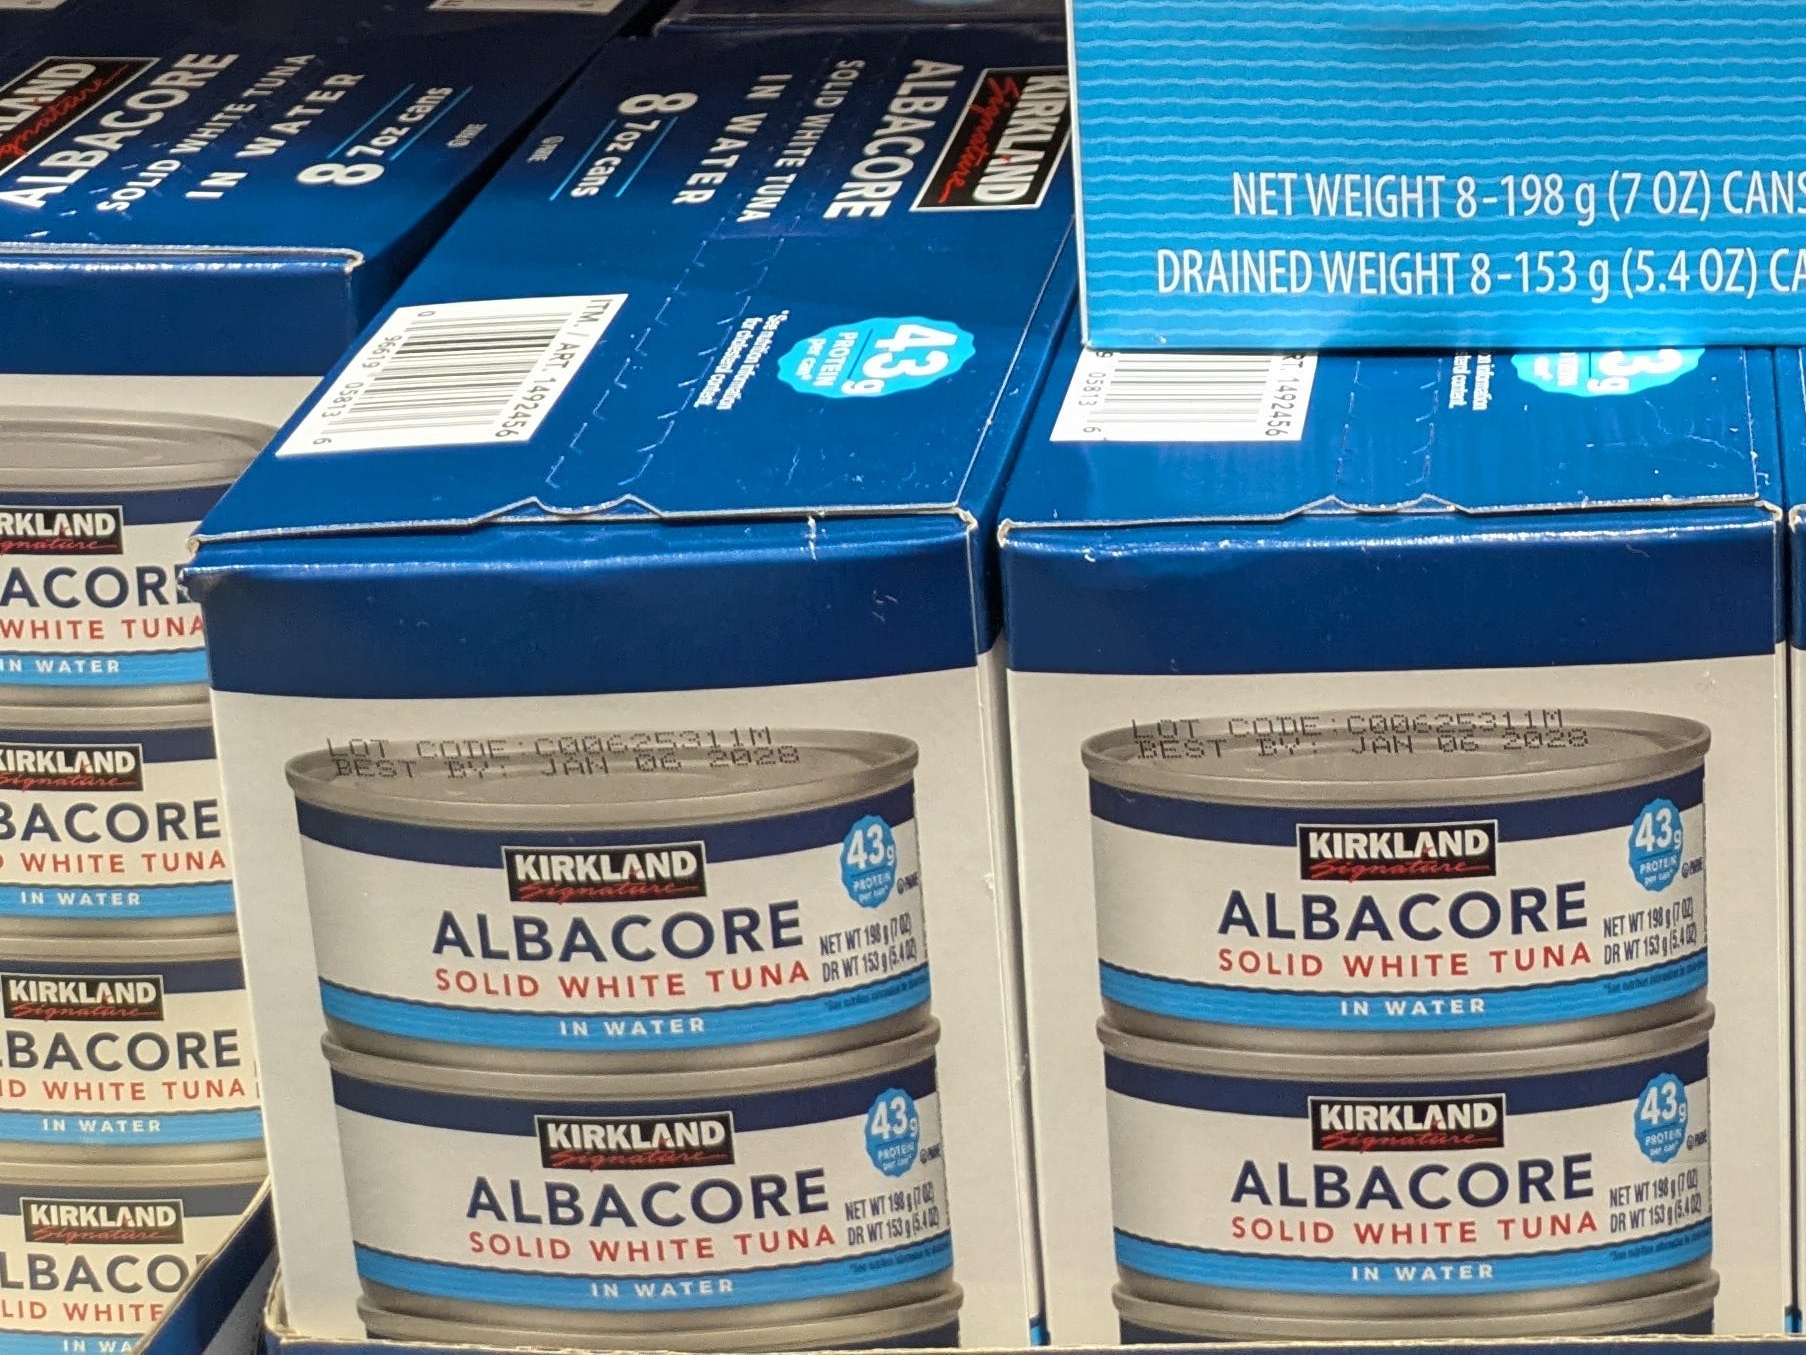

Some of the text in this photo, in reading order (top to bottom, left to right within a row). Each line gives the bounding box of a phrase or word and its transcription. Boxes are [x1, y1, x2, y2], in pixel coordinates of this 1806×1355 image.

[0, 53, 240, 209] ALBACORE
[570, 92, 699, 199] 8 7oz cans
[671, 74, 794, 205] IN WATER
[736, 60, 866, 224] SOLID WHITE TUNA
[822, 58, 965, 220] ALBACORE
[970, 75, 1069, 203] KIRKLAND
[1233, 172, 1297, 216] NET
[1306, 174, 1445, 219] WEIGHT
[1576, 184, 1596, 226] g
[1608, 171, 1642, 222] (7
[1653, 171, 1710, 220] OZ)
[1157, 249, 1312, 294] DRAINED
[1321, 252, 1460, 296] WEIGHT
[1588, 260, 1609, 303] g
[1621, 248, 1690, 299] (5.4
[1700, 248, 1757, 299] OZ)
[813, 332, 859, 387] PROTEIN
[841, 324, 958, 395] 43g
[495, 377, 557, 438] 1492456
[35, 659, 121, 674] WATER
[336, 759, 418, 779] BEST
[541, 756, 608, 776] JAN
[1139, 740, 1226, 759] BEST
[1352, 735, 1414, 755] JAN
[847, 823, 895, 870] 43g
[1310, 828, 1489, 859] KIRKLAND
[1635, 807, 1682, 852] 43g
[20, 850, 226, 874] WHITE TUNA
[515, 849, 698, 882] KIRKLAND
[432, 900, 803, 962] ALBACORE
[1218, 881, 1588, 942] ALBACORE
[1603, 915, 1625, 938] NET
[1628, 911, 1645, 933] WT
[435, 960, 810, 999] SOLID WHITE TUNA
[1219, 942, 1592, 978] SOLID WHITE TUNA
[8, 980, 157, 1005] KIRKLAND
[1340, 998, 1486, 1016] IN WATER
[560, 1017, 705, 1036] IN WATER
[43, 1078, 245, 1101] WHITE TUNA
[546, 1119, 725, 1150] KIRKLAND
[1320, 1103, 1499, 1132] KIRKLAND
[466, 1168, 830, 1228] ALBACORE
[1230, 1152, 1594, 1211] ALBACORE
